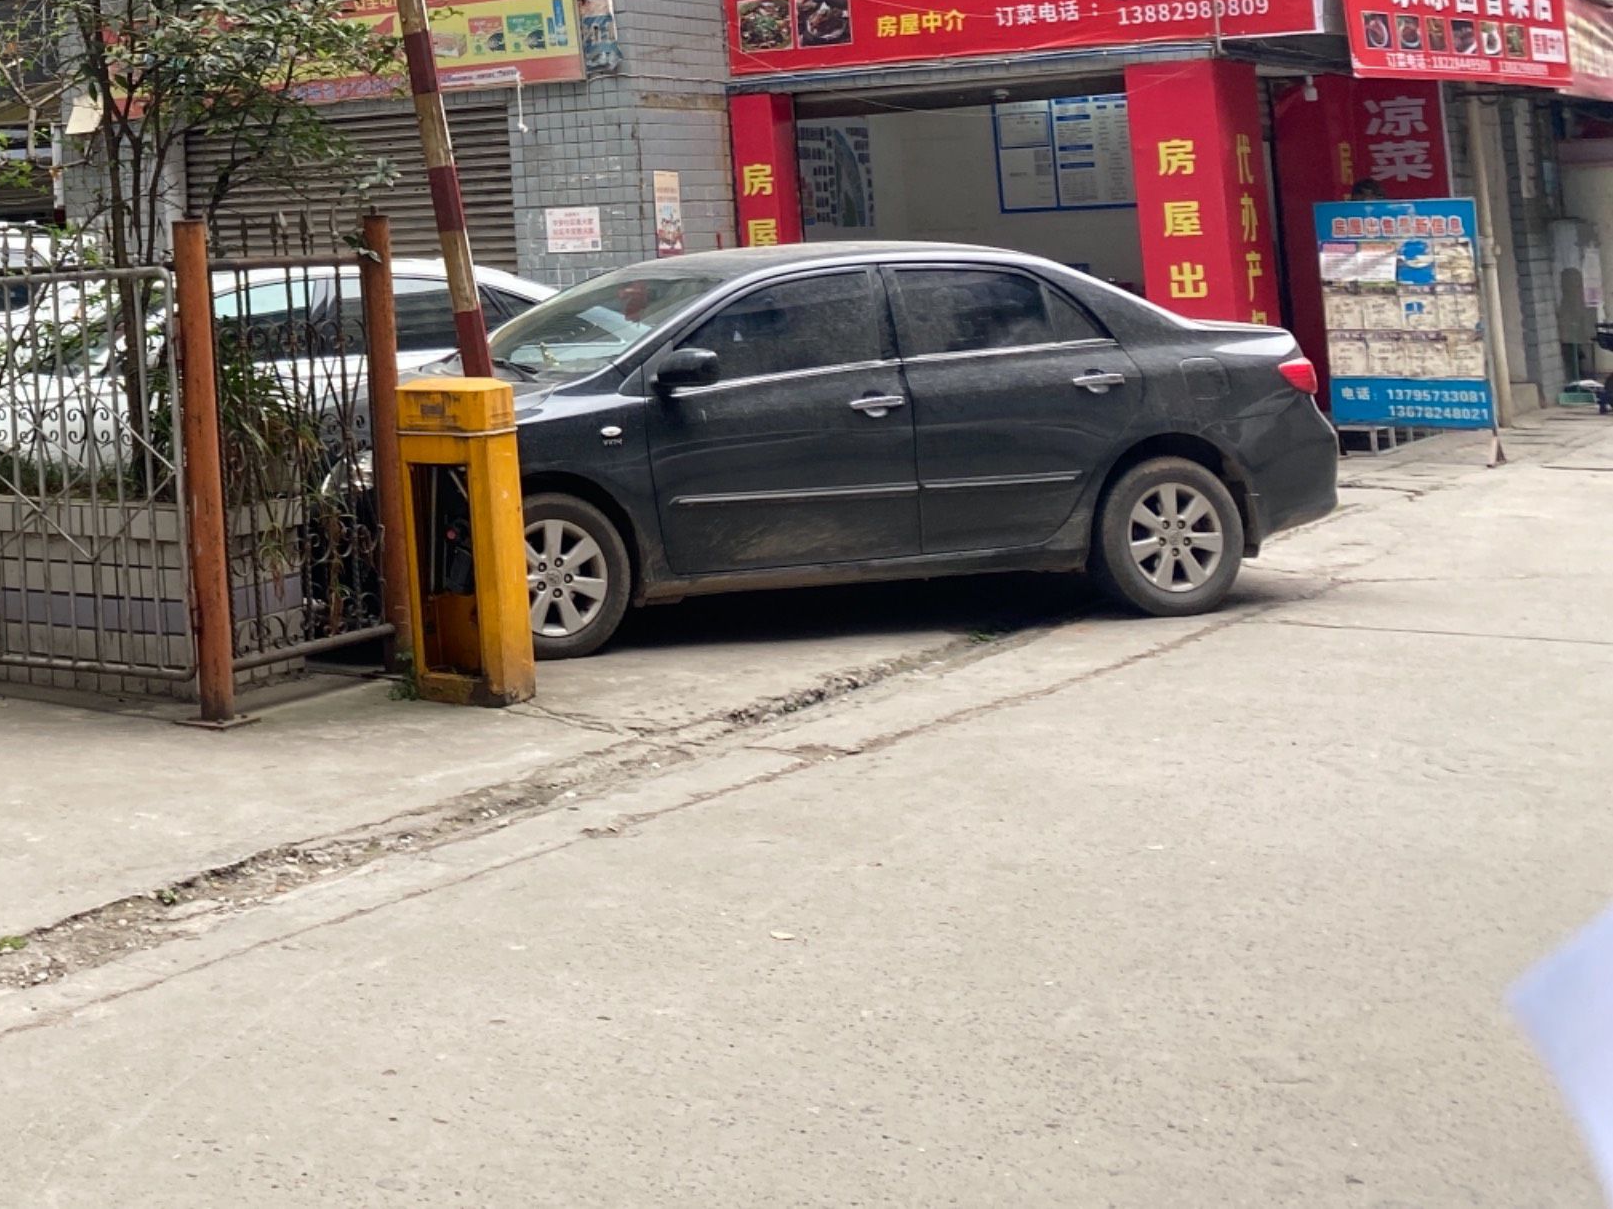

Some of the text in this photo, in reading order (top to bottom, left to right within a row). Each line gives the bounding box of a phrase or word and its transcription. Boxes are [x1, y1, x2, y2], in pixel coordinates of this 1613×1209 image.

[876, 9, 966, 38] 房屋中介
[1363, 95, 1434, 183] 凉菜
